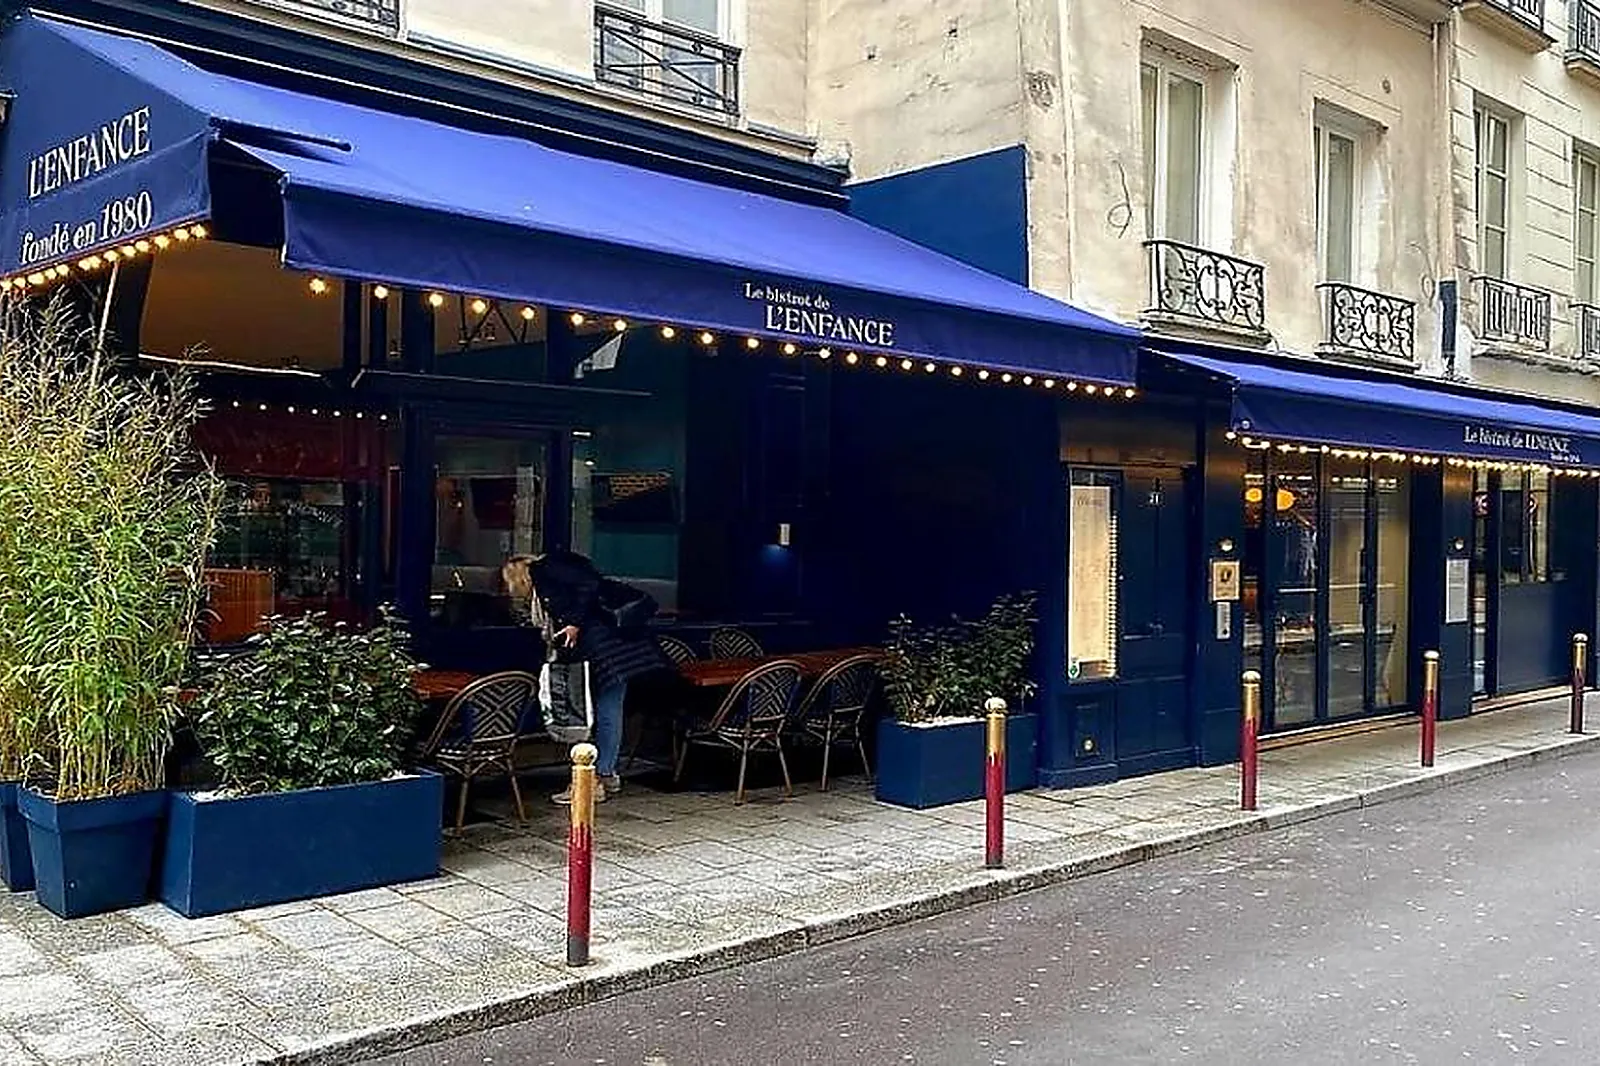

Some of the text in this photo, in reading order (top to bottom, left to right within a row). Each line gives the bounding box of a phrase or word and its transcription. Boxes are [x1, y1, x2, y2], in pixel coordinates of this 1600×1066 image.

[29, 107, 151, 199] L'ENFANCE
[21, 191, 152, 264] fondé en 1980
[744, 283, 830, 310] Le bistrot de
[766, 305, 893, 346] L'ENFANCE
[1464, 426, 1478, 443] Le
